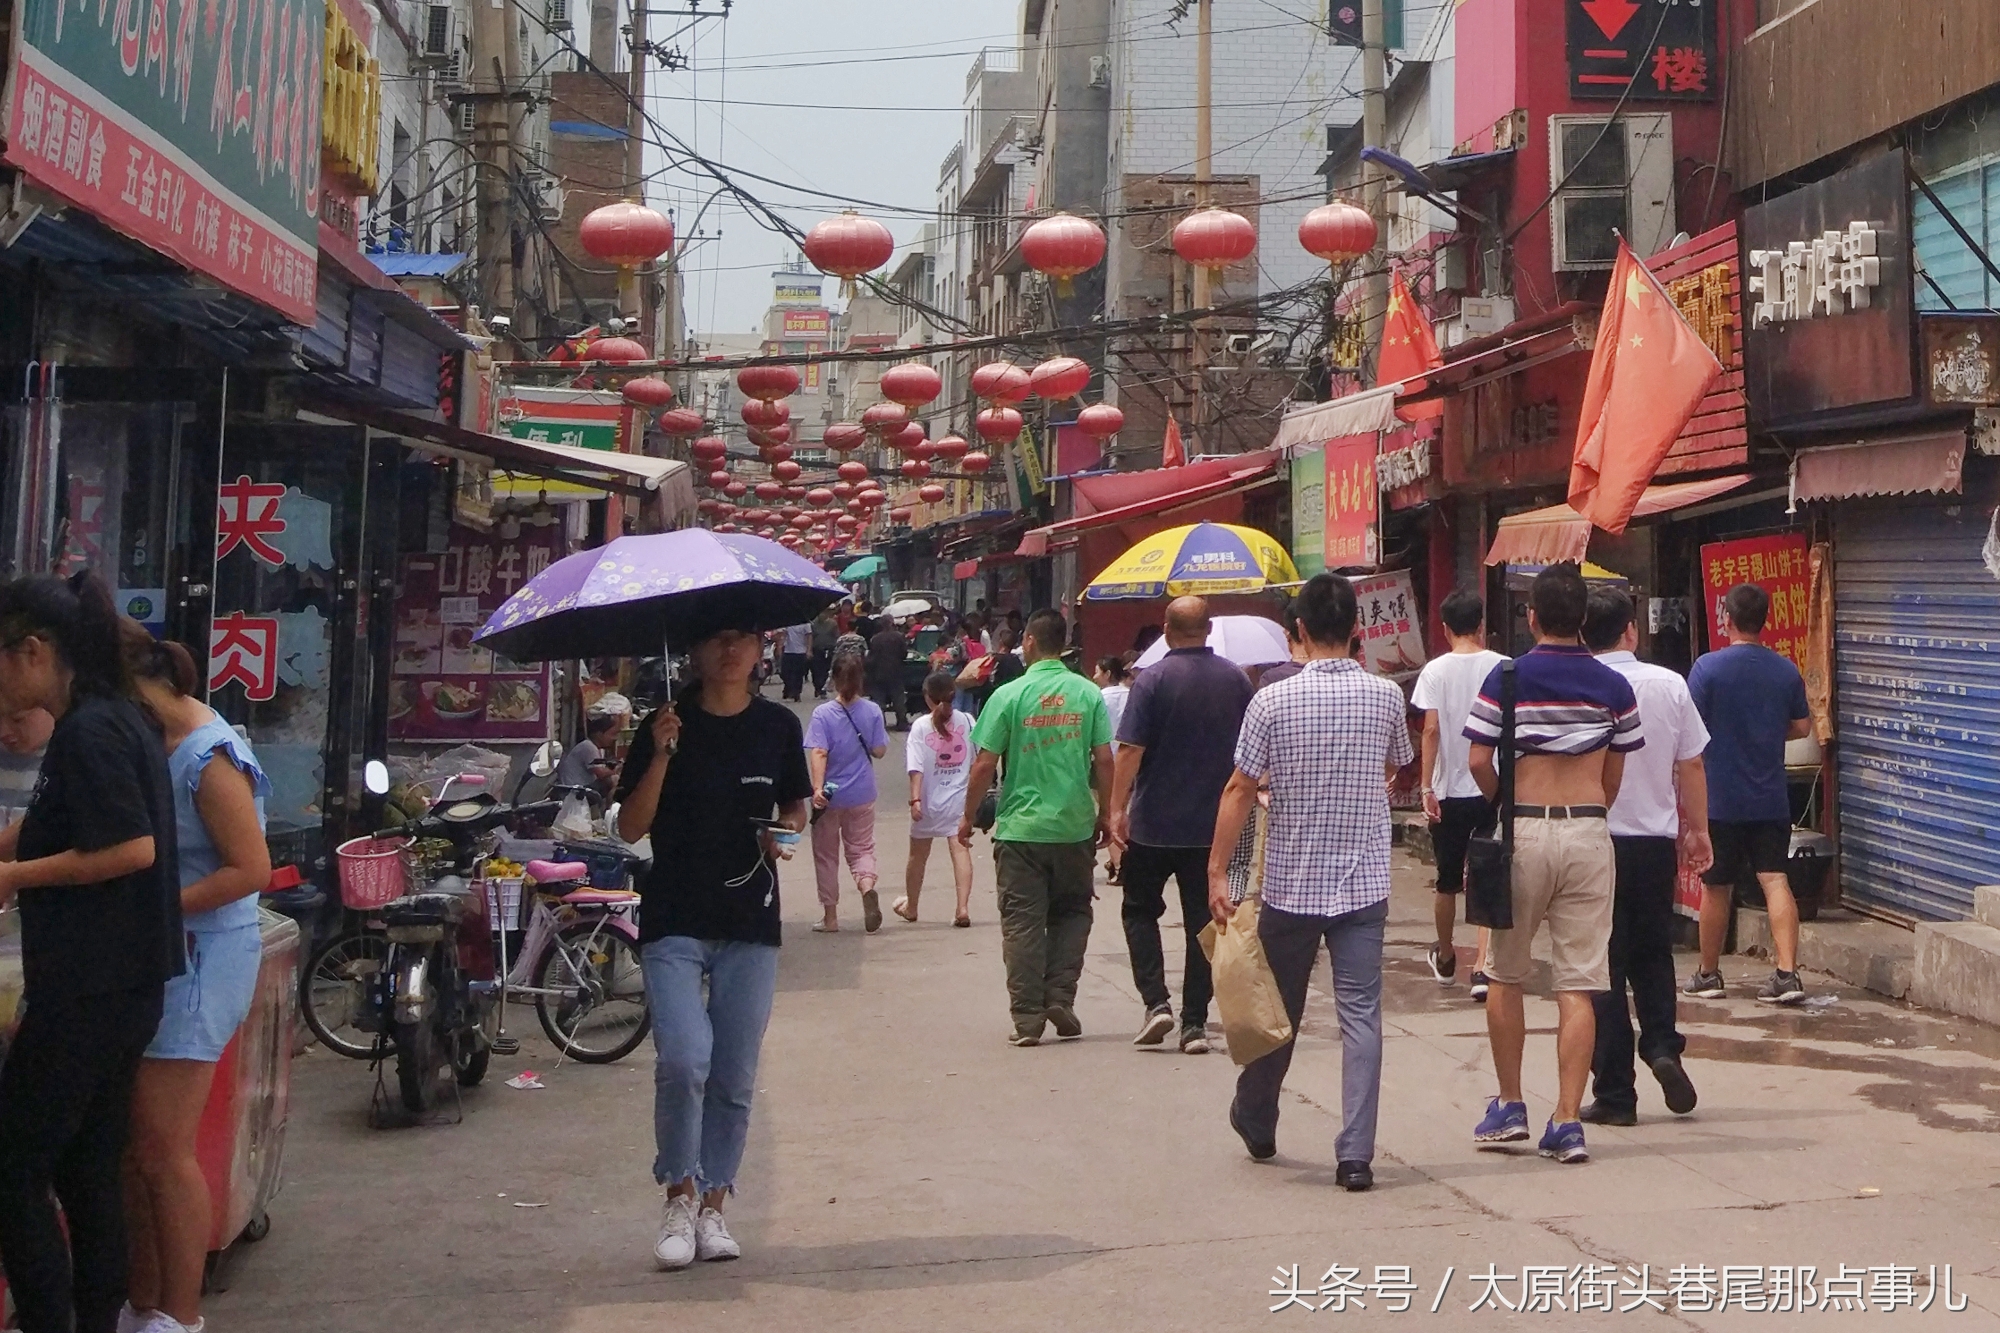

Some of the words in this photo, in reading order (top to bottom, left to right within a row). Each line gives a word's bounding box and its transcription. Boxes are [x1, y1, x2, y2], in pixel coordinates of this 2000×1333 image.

[1578, 46, 1708, 92] 二楼
[18, 74, 108, 191] 烟酒副食
[120, 145, 188, 235] 五金日化
[260, 236, 314, 307] 小花园布鞋
